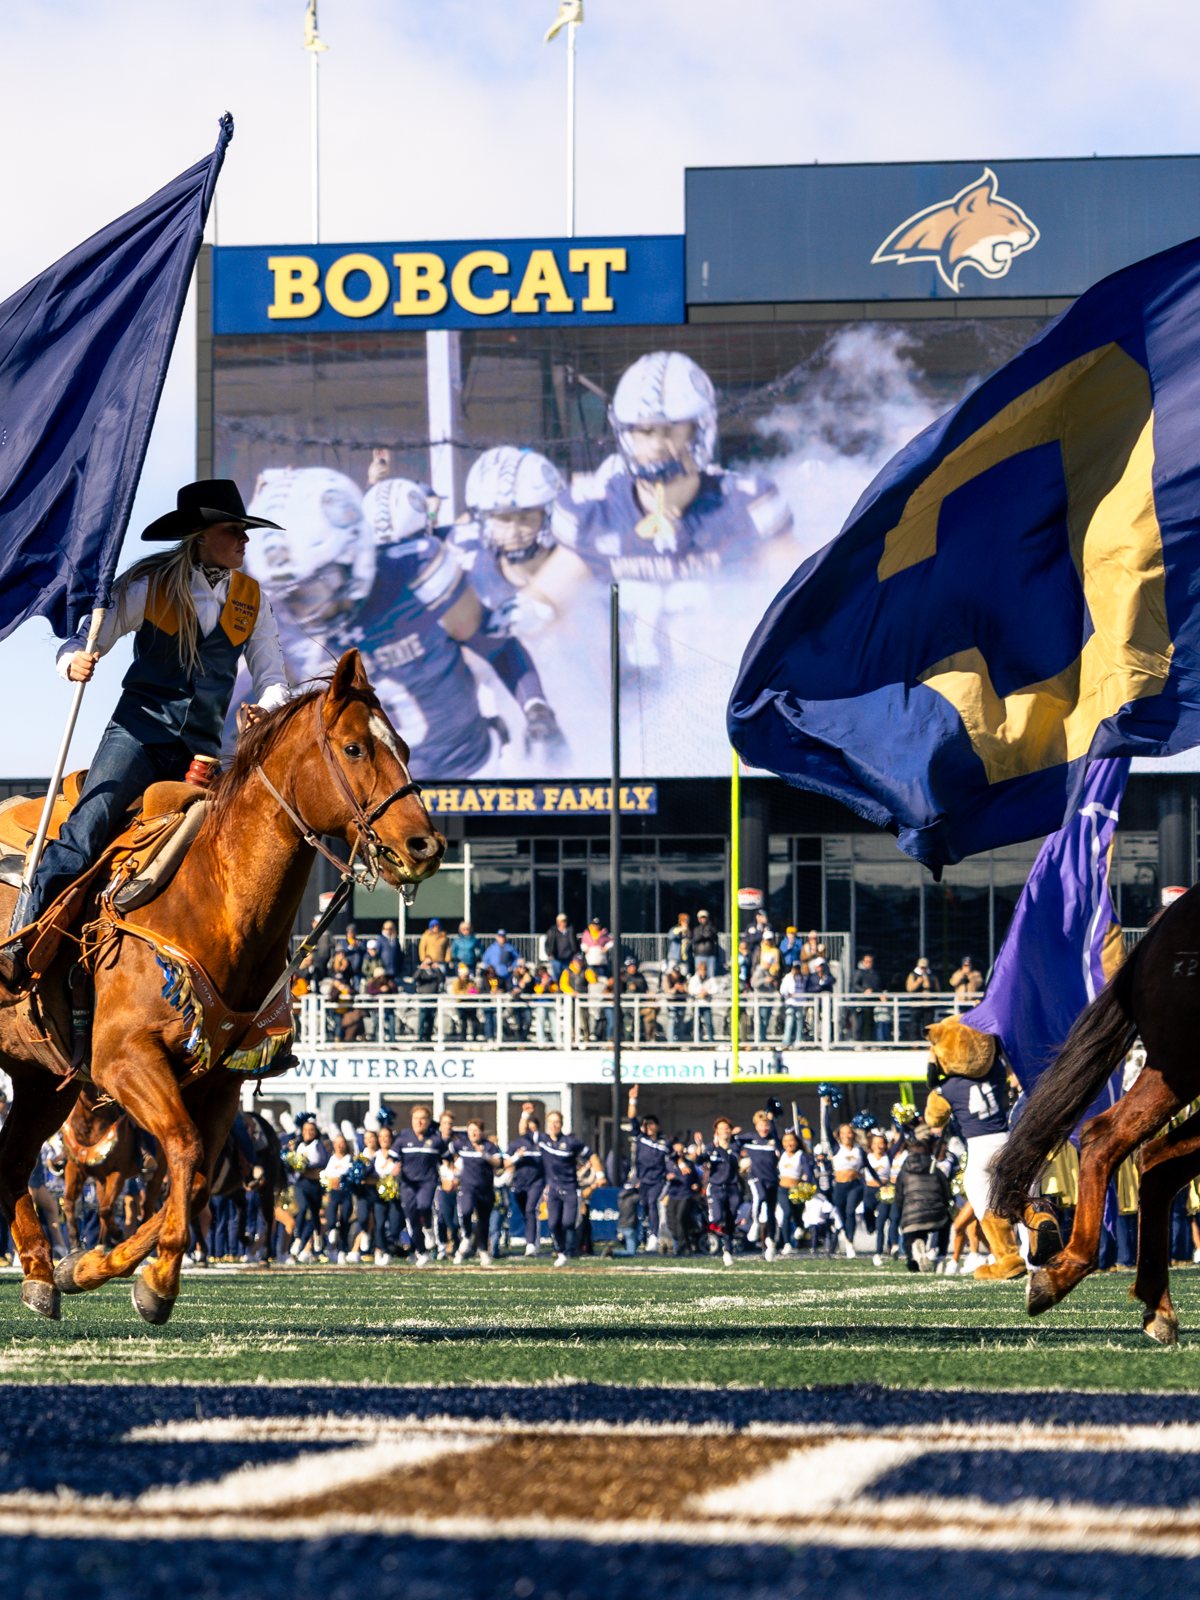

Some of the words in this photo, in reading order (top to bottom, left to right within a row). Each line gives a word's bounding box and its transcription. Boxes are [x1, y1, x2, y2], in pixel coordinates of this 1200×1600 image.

[267, 248, 627, 319] BOBCAT
[420, 787, 537, 812] THAYER
[256, 1001, 288, 1029] WILLIAMS
[289, 1058, 339, 1078] WN
[348, 1058, 476, 1079] TERRACE
